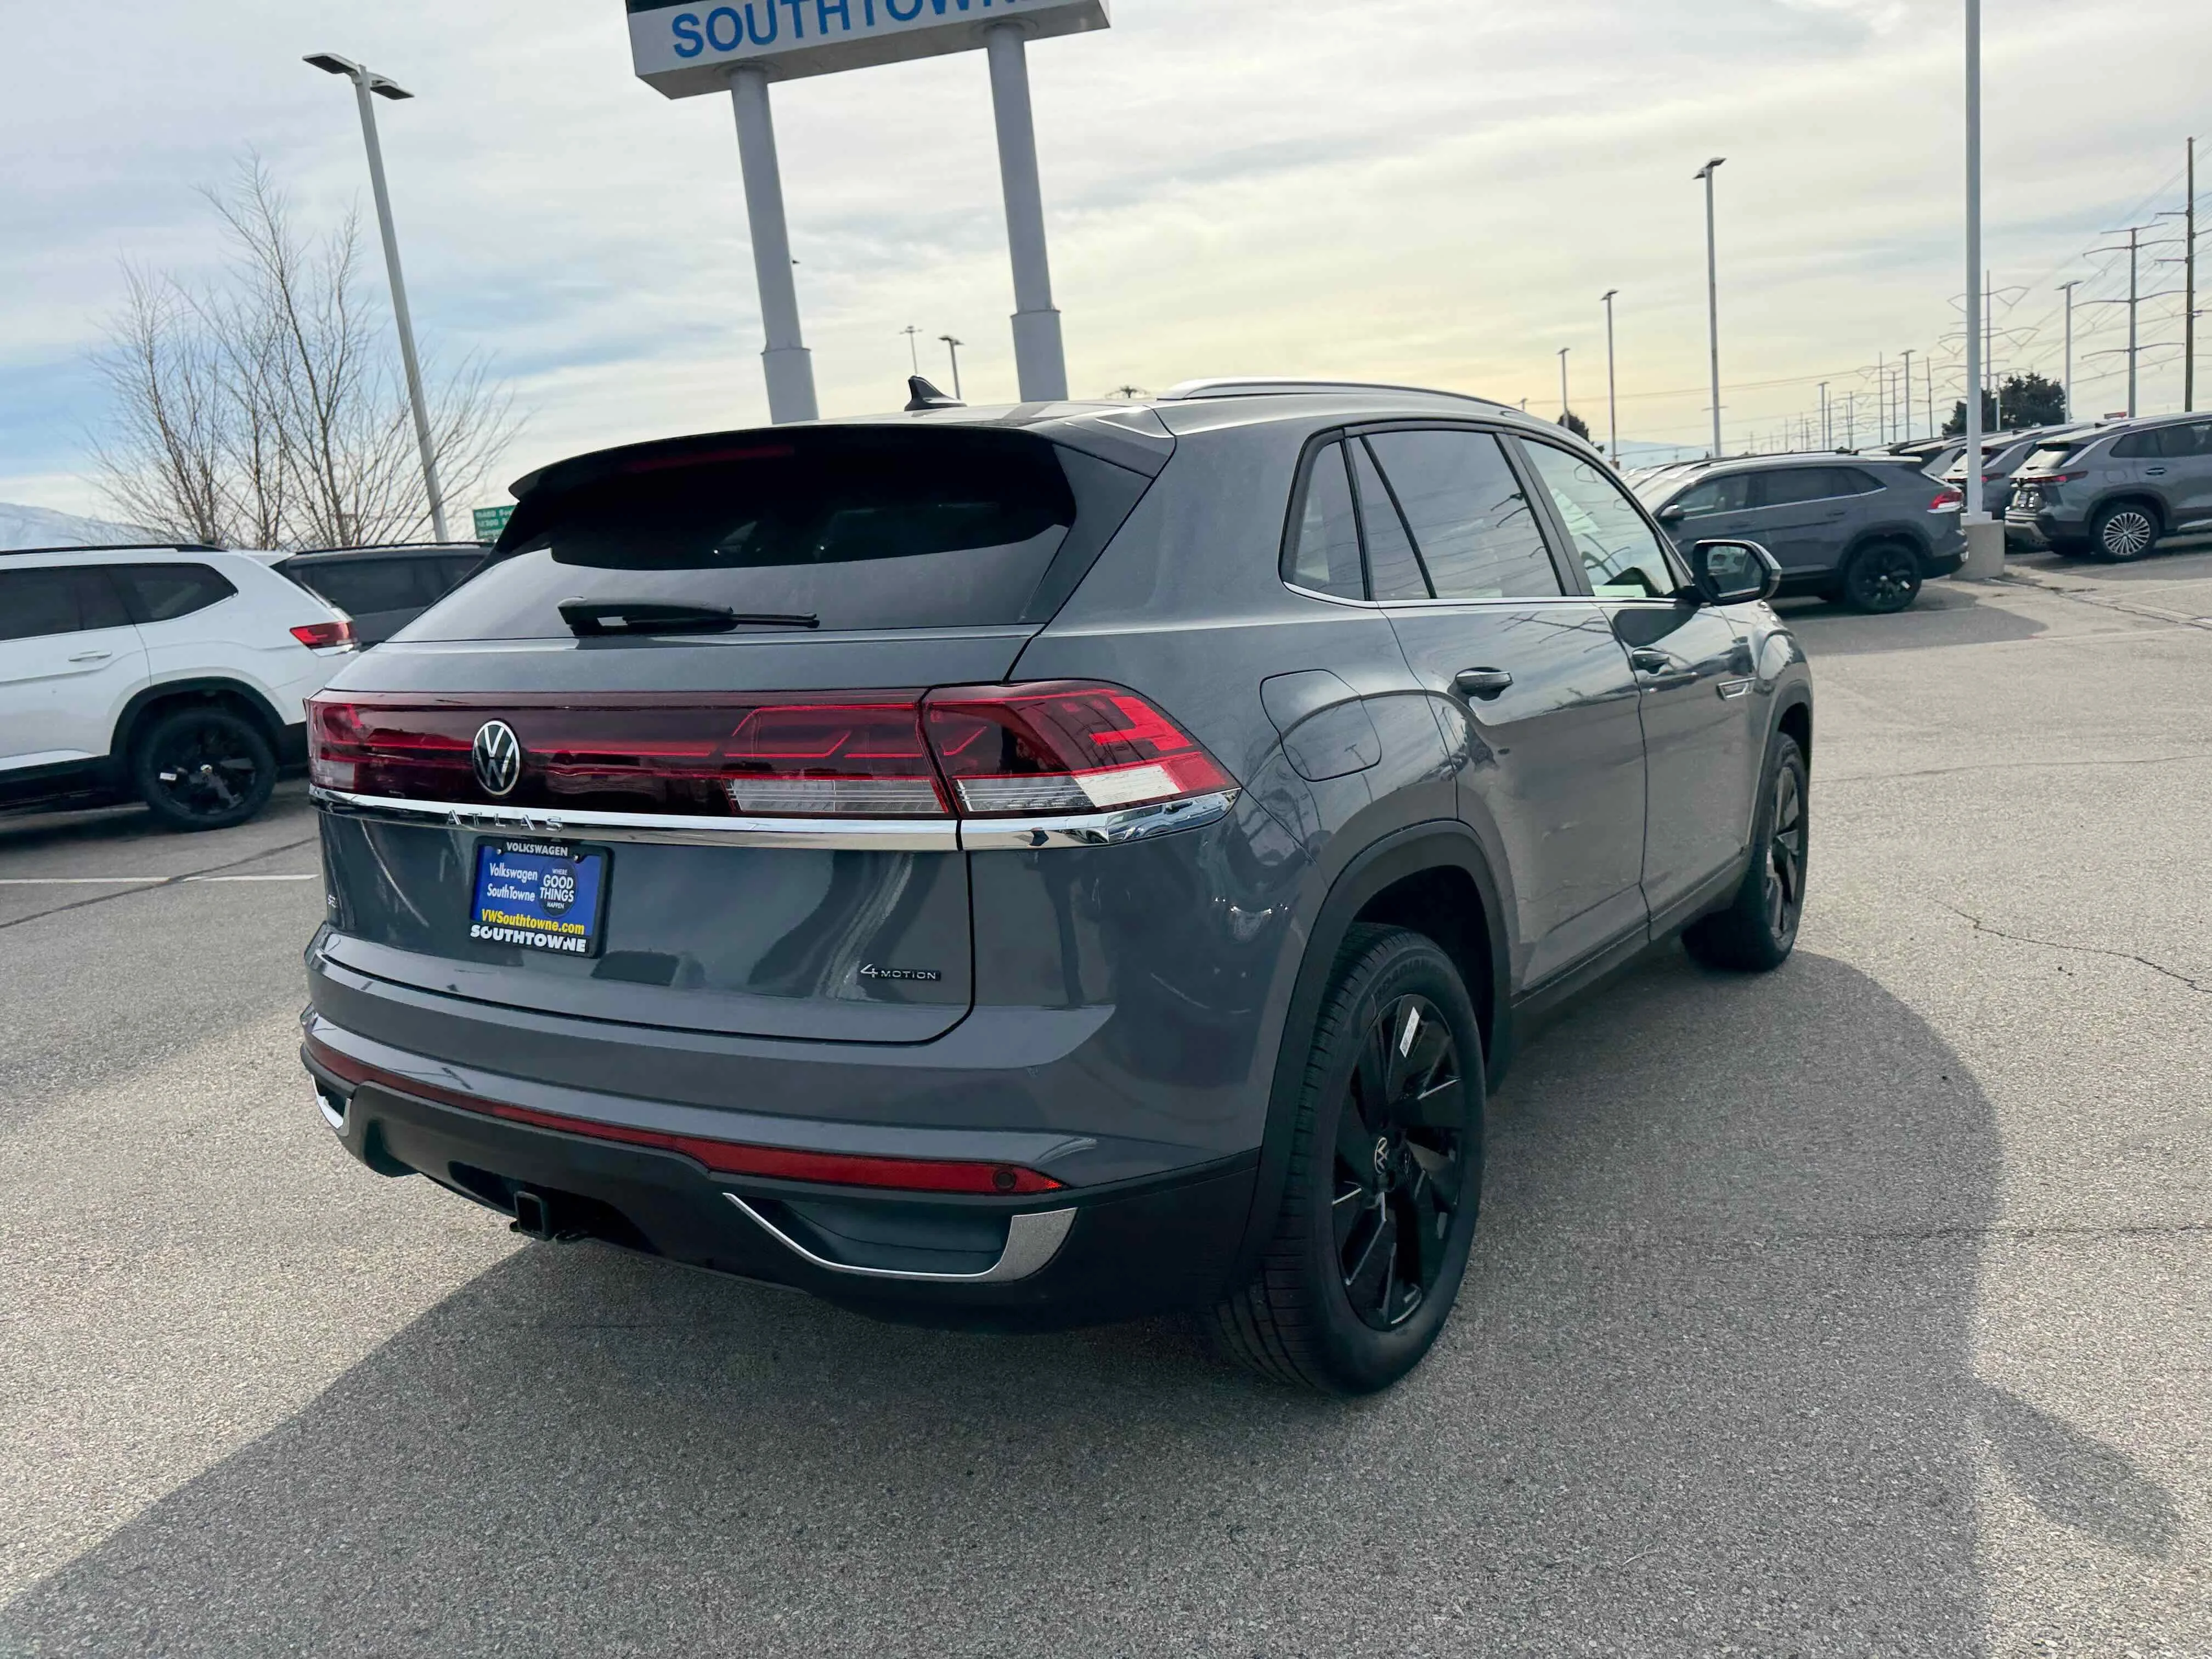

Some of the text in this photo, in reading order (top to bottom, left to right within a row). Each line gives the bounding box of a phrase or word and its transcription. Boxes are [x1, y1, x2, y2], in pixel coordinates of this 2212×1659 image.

[446, 809, 564, 832] ATLAS
[506, 842, 568, 856] VOLKSWAGEN
[489, 862, 538, 883] Volkswagen
[543, 874, 574, 889] GOOD
[487, 883, 536, 902] SouthTowne
[540, 887, 574, 902] THINGS
[482, 909, 585, 935] VWSouthtowne.com
[470, 925, 587, 953] SOUTHTOWNE
[860, 963, 936, 979] 4MOTION
